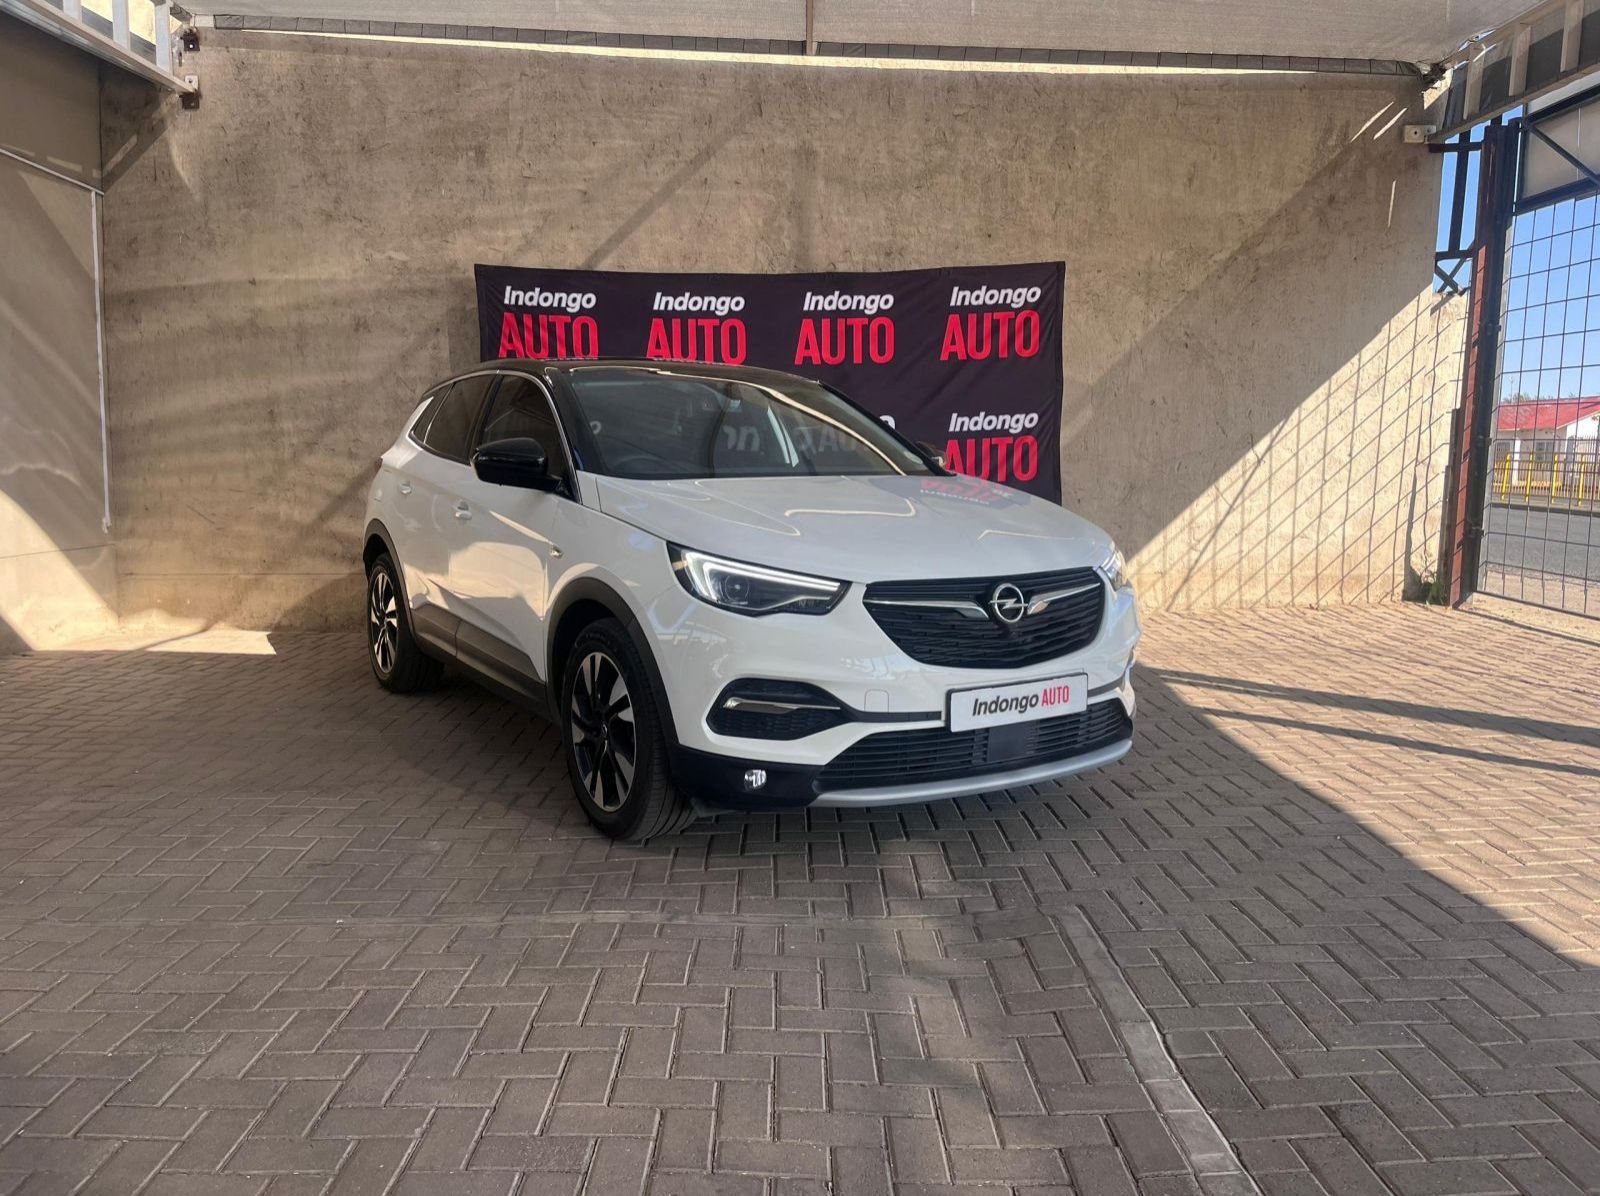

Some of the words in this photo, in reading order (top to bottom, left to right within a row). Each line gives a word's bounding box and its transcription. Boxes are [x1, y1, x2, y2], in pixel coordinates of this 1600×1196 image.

[504, 286, 596, 313] Indongo
[653, 292, 745, 315] Indongo
[803, 292, 894, 314] Indongo
[950, 286, 1041, 309] Indongo
[500, 313, 598, 359] AUTO
[647, 319, 746, 363] AUTO
[795, 318, 894, 365] AUTO
[941, 311, 1040, 360] AUTO
[949, 412, 1038, 434] Indongo
[946, 436, 1038, 481] AUTO
[972, 694, 1039, 716] Indongo
[1043, 686, 1070, 707] AUTO
